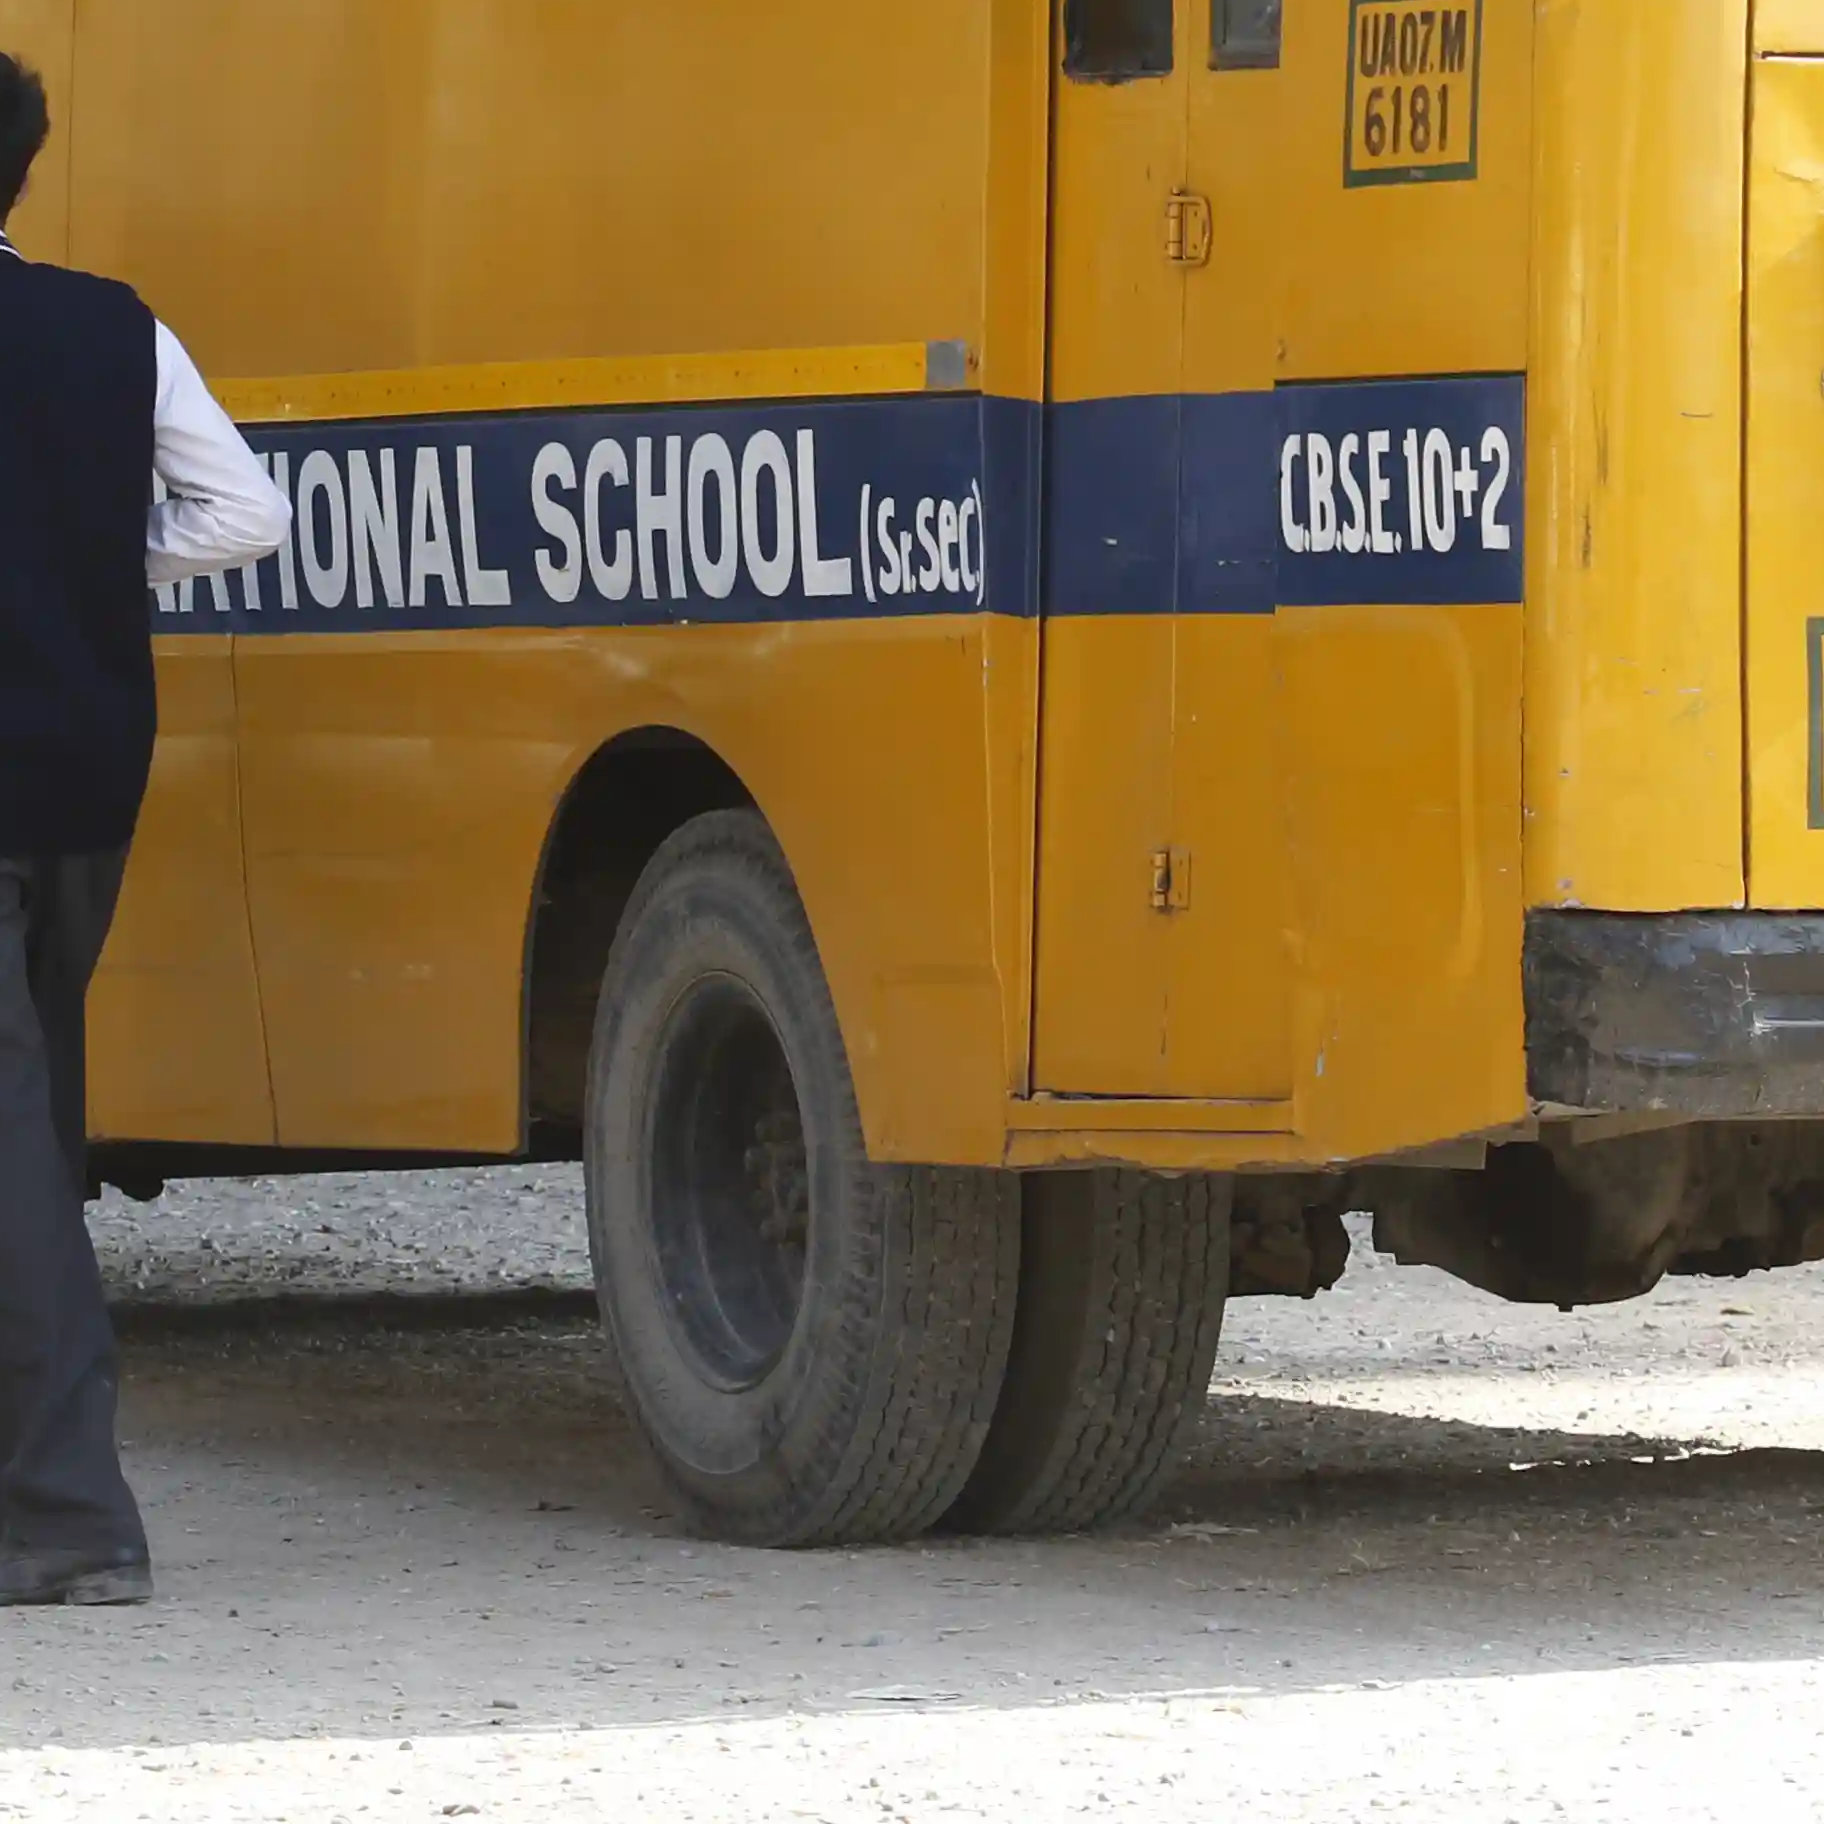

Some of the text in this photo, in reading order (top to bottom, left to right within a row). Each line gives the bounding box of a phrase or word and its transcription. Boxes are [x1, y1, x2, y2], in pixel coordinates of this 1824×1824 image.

[1364, 84, 1449, 157] 6181
[152, 445, 511, 612] IONAL
[531, 428, 852, 605] SCHOOL
[1402, 426, 1511, 552] 10+2
